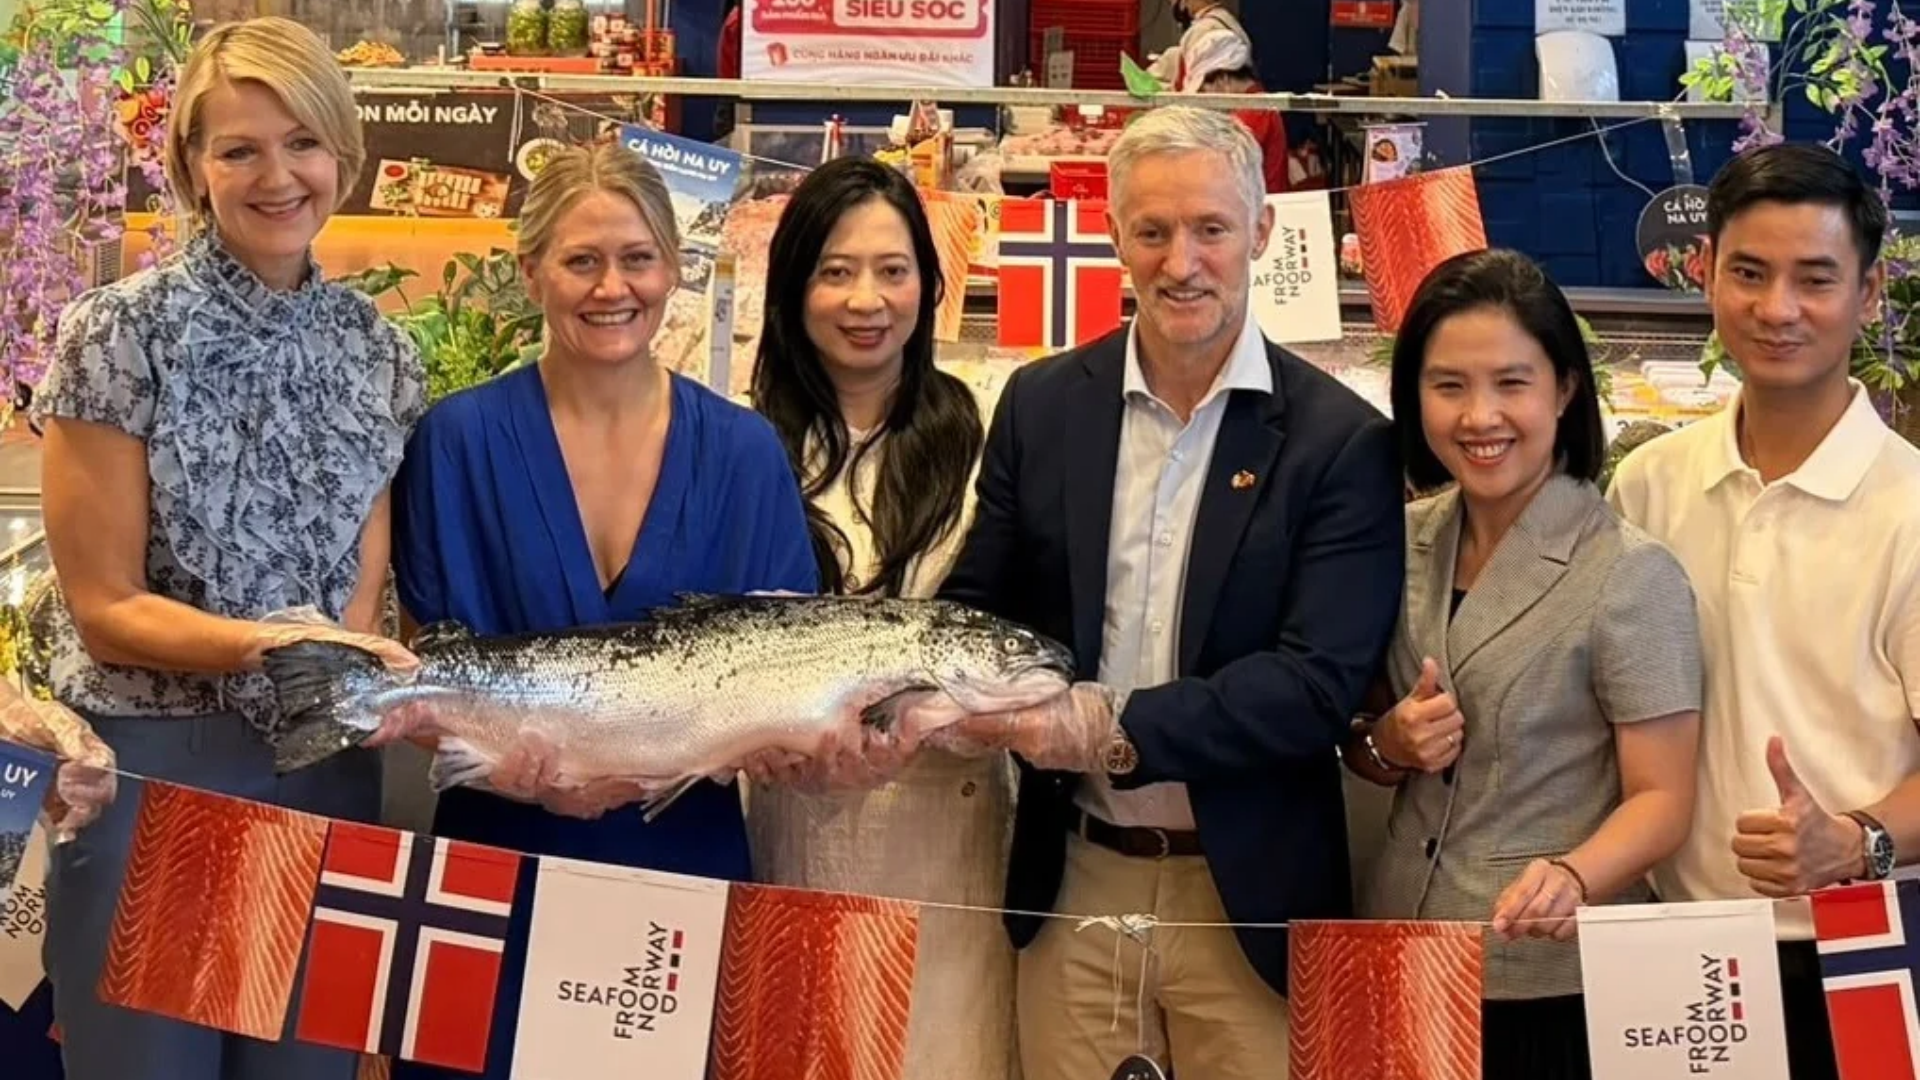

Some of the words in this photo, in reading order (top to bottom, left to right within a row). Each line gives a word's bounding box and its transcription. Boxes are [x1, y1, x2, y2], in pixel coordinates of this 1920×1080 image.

[385, 100, 430, 123] MỖI
[434, 103, 498, 124] NGÀY
[682, 151, 704, 169] NA
[708, 159, 731, 174] UY
[1667, 211, 1688, 225] NA
[1689, 211, 1708, 223] UY
[1253, 271, 1312, 286] AFOOD
[1282, 226, 1301, 297] NORWAY
[1273, 257, 1287, 305] FROM
[4, 763, 38, 788] UY
[637, 921, 668, 1031] NORWAY
[558, 980, 677, 1014] SEAFOOD
[613, 967, 641, 1039] FROM
[1700, 953, 1730, 1062] NORWAY
[1624, 1024, 1748, 1048] SEAFOOD
[1686, 1002, 1710, 1073] FROM
